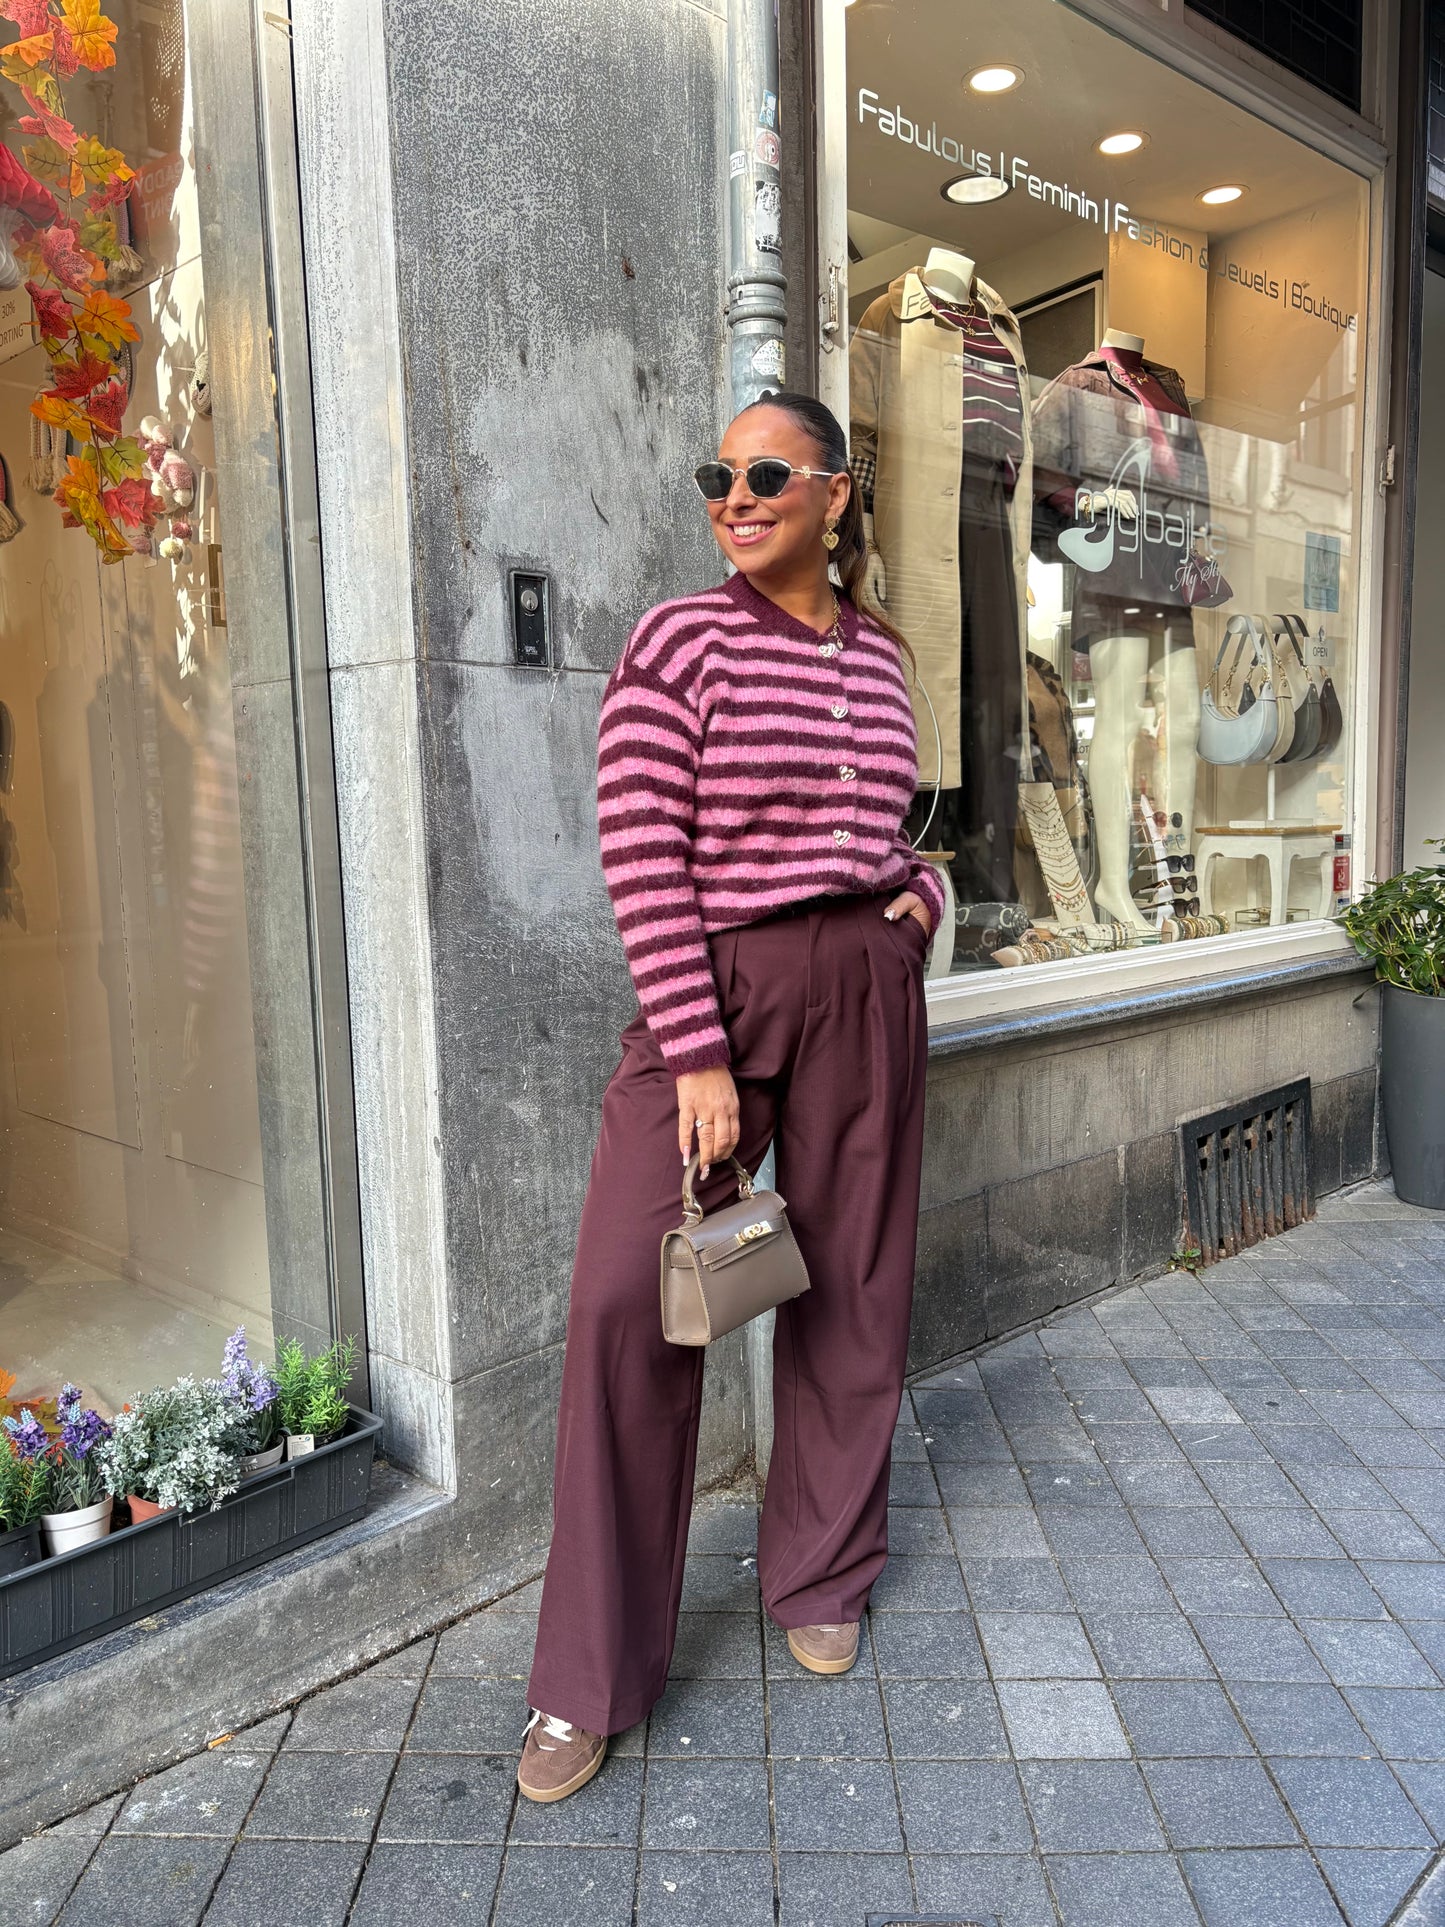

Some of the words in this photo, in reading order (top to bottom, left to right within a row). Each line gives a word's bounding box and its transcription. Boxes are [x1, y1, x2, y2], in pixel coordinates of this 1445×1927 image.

[858, 87, 992, 178] Fabulous
[1012, 156, 1099, 224] Feminin
[1114, 202, 1194, 264] Fashion
[1216, 251, 1280, 300] Jewels
[1291, 281, 1358, 333] Boutique
[1312, 646, 1328, 658] OPEN
